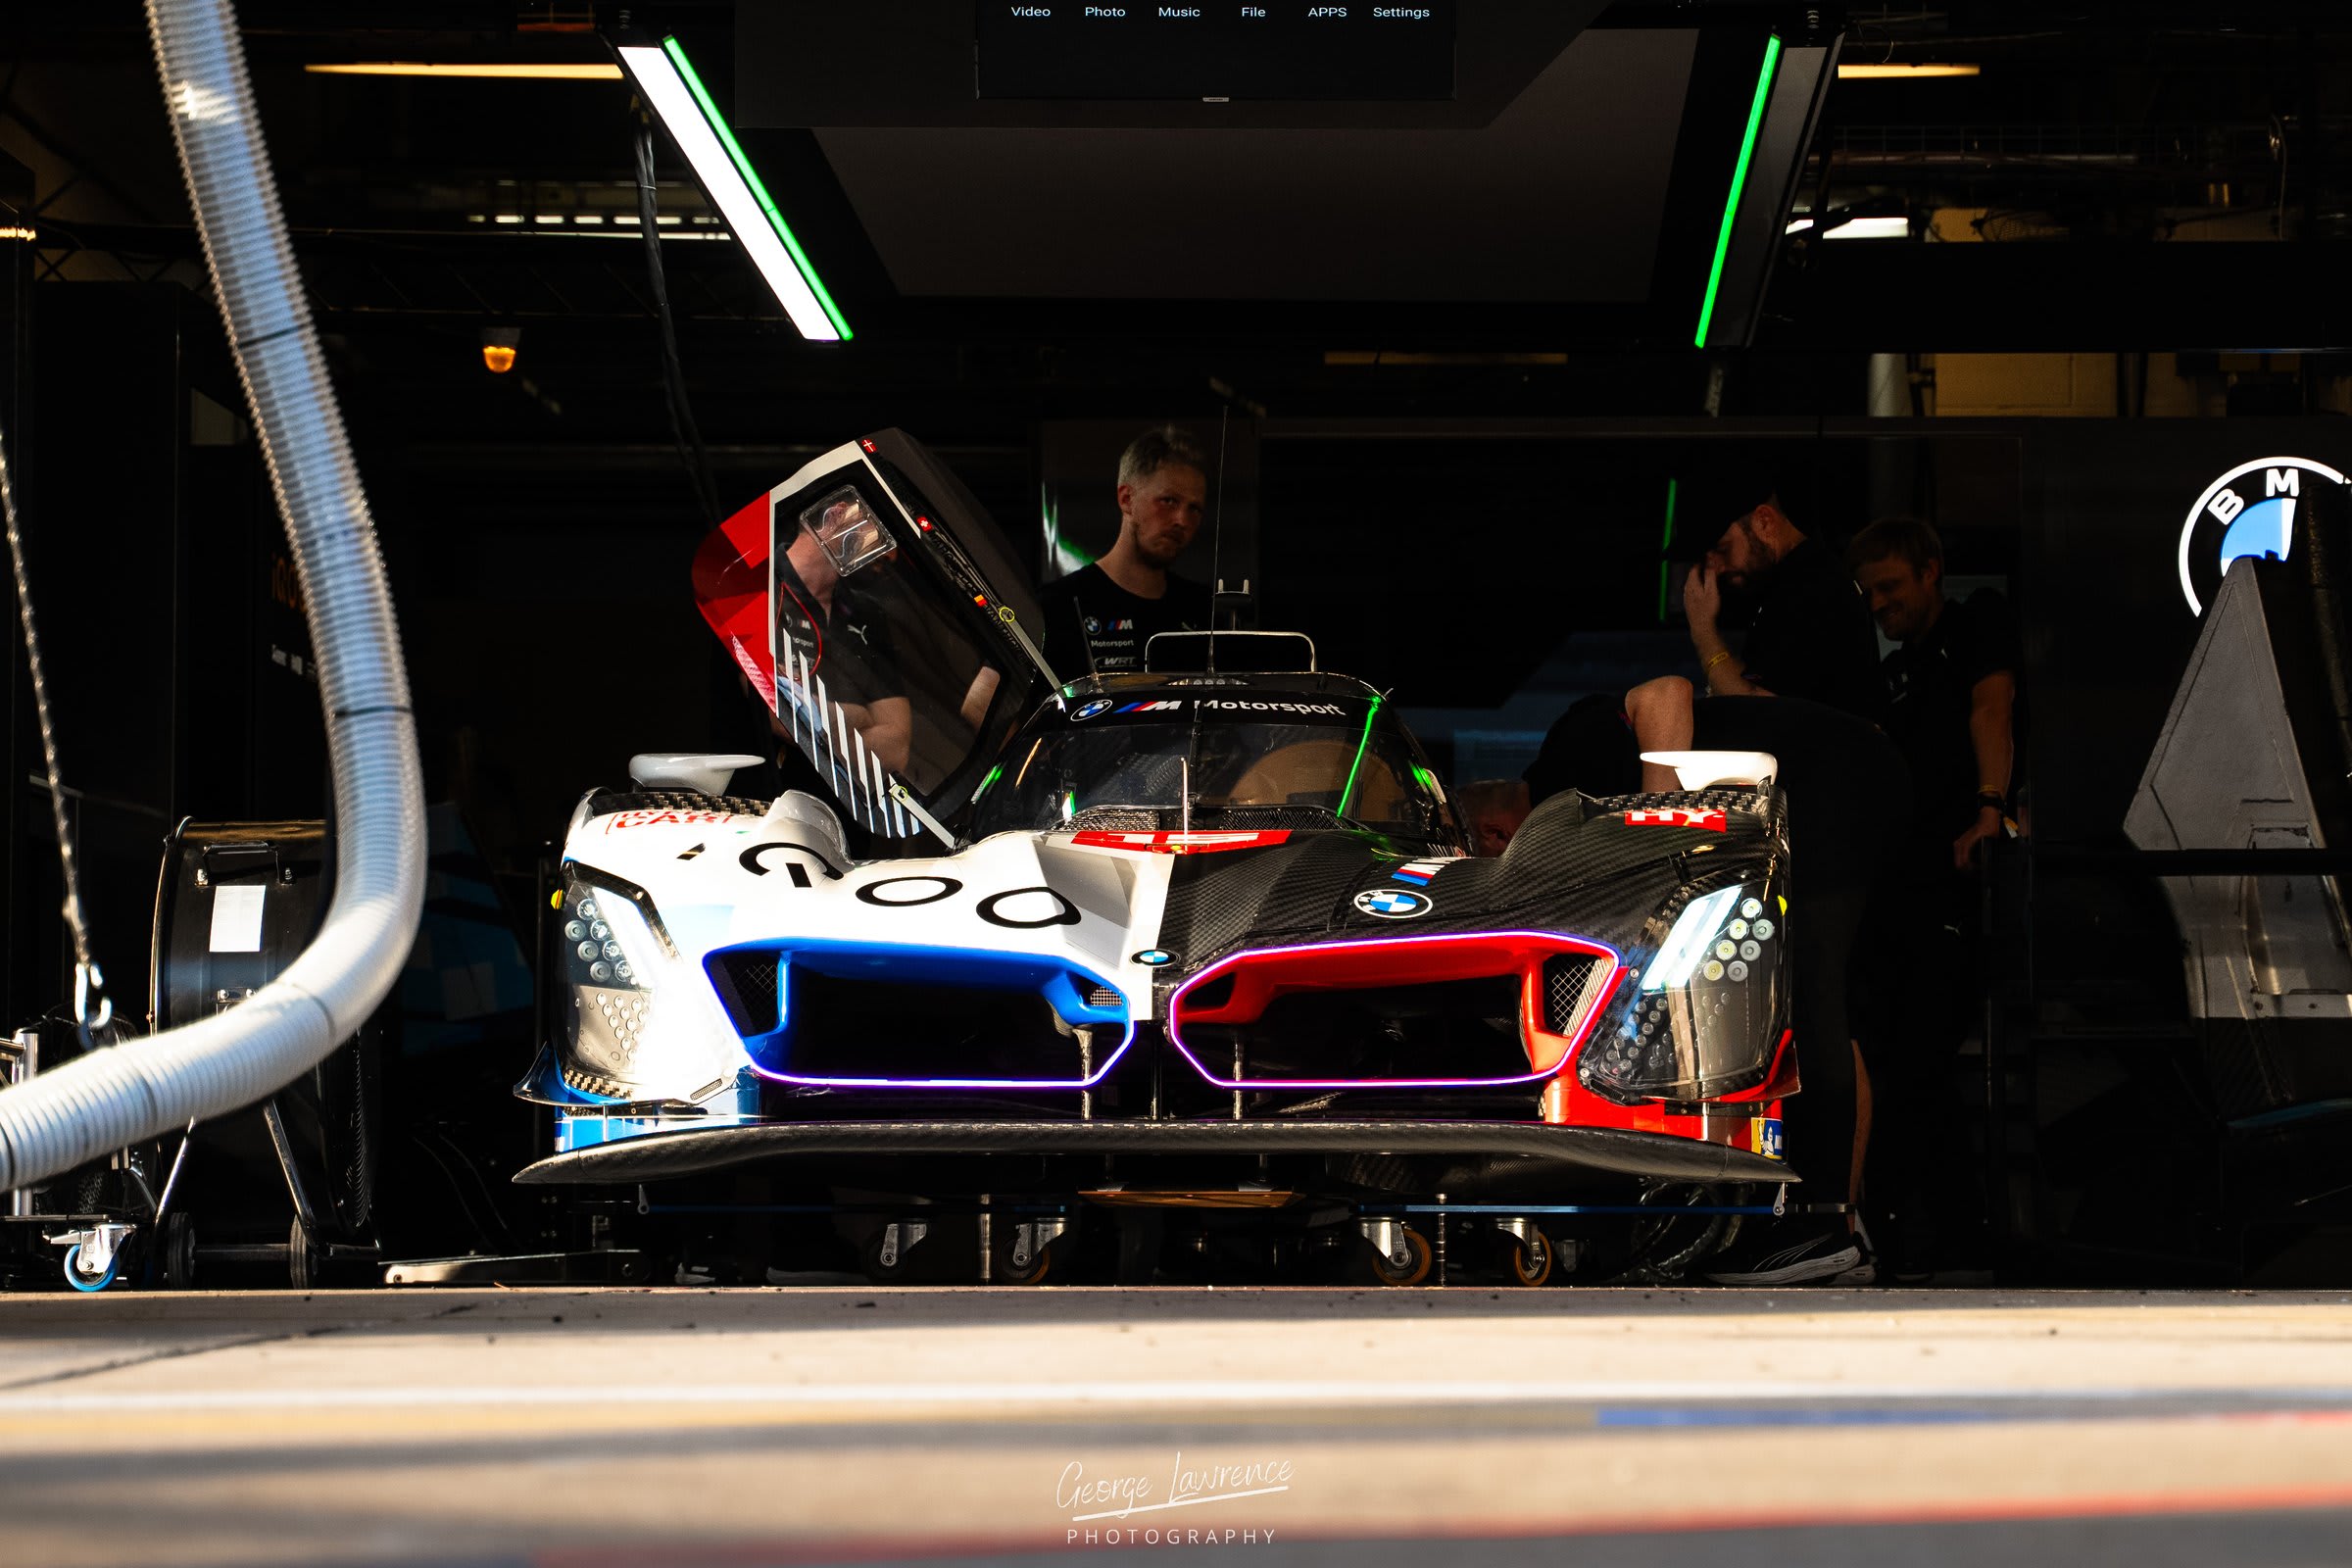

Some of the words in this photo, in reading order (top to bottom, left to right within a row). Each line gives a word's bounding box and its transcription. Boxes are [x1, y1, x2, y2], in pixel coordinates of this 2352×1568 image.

[1010, 6, 1051, 17] Video
[1085, 6, 1126, 17] Photo
[1158, 6, 1200, 17] Music
[1242, 6, 1266, 17] File
[1308, 6, 1348, 17] APPS
[1373, 6, 1430, 19] Settings
[2207, 467, 2300, 525] BM
[1090, 639, 1135, 648] Motorsport
[1194, 700, 1348, 716] Motorsport
[615, 814, 718, 829] CAR
